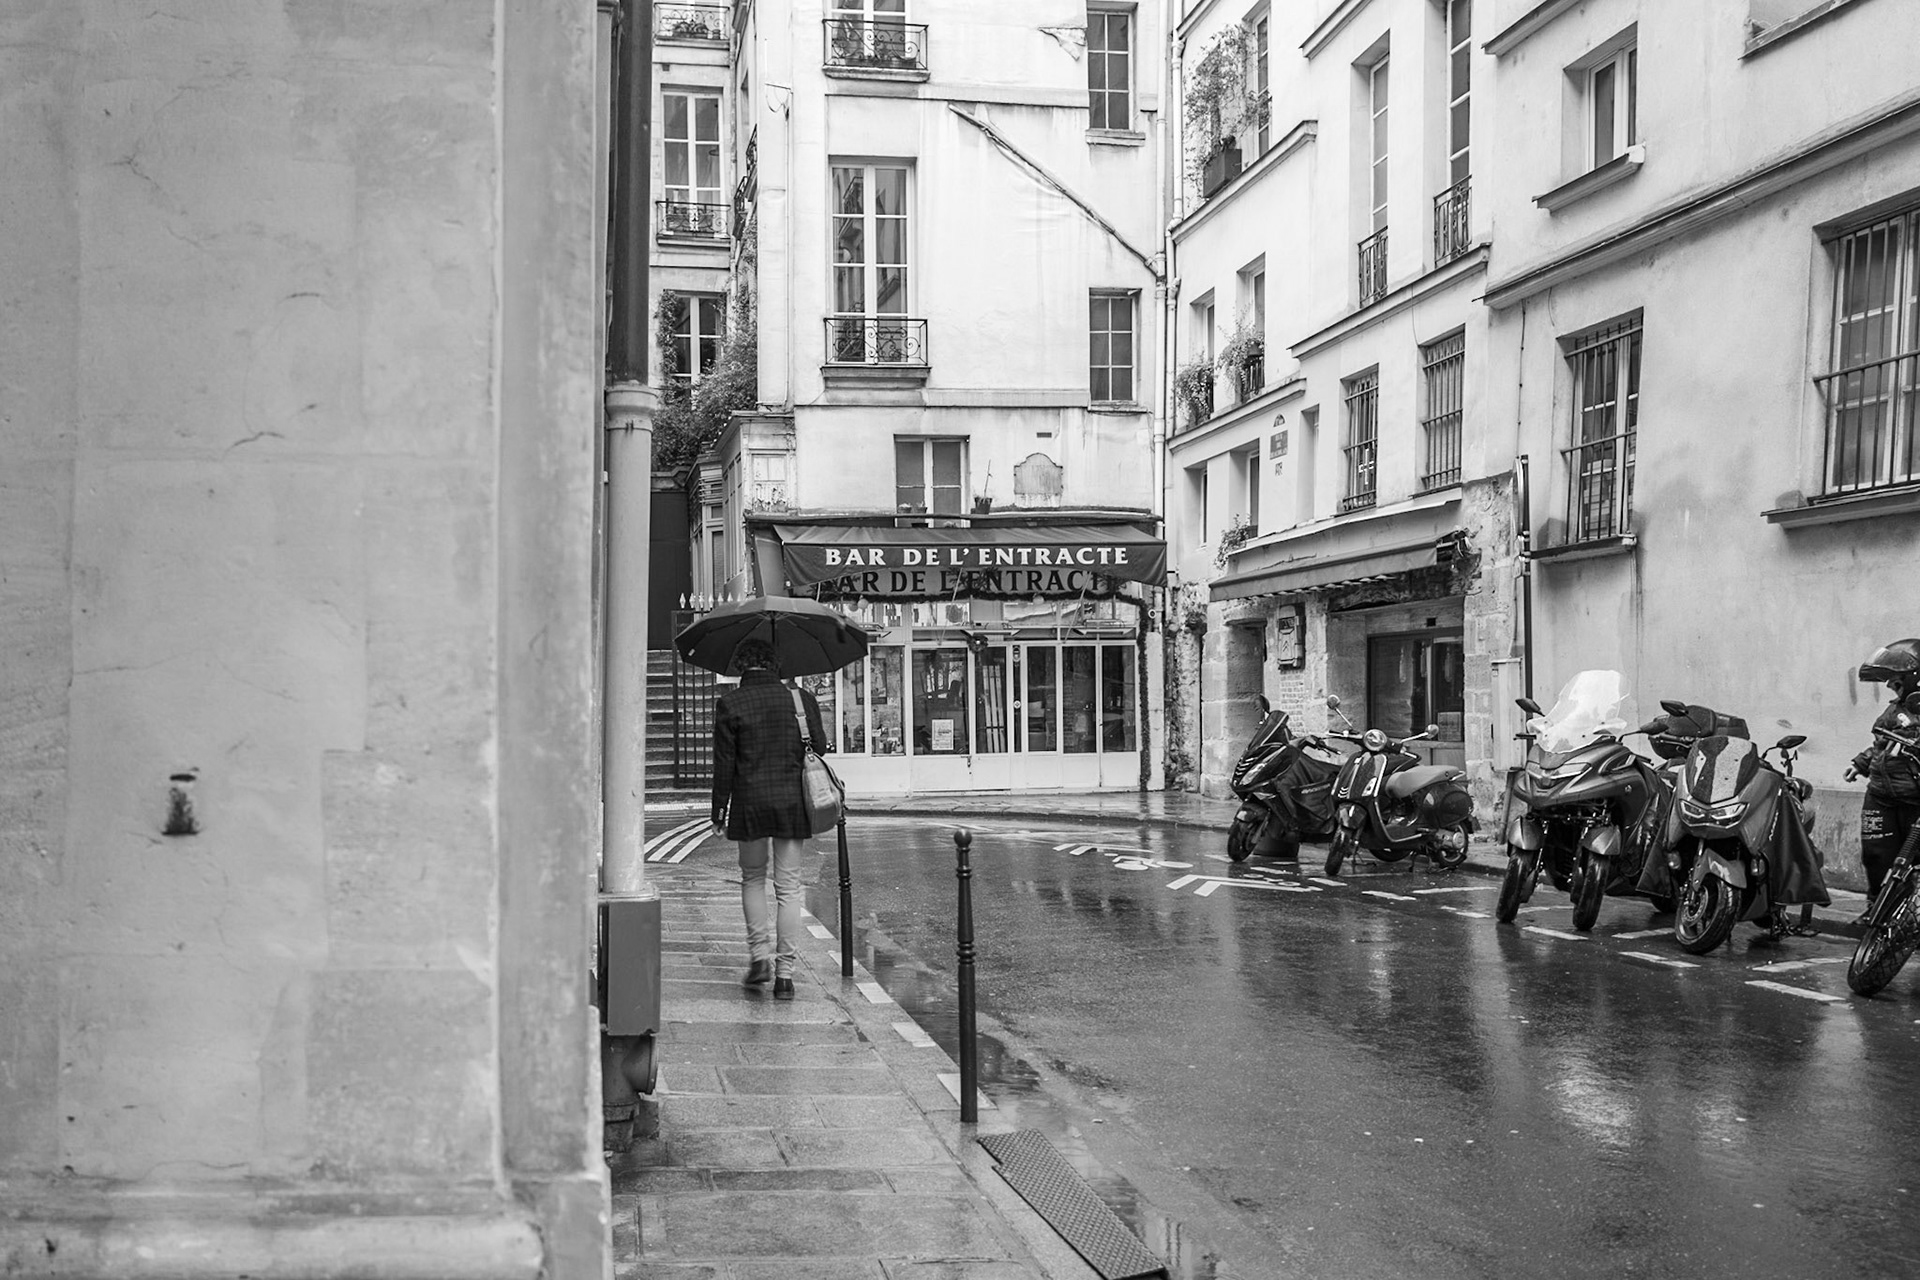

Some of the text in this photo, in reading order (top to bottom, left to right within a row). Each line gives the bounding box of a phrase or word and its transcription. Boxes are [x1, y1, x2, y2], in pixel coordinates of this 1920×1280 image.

[825, 548, 886, 566] BAR
[903, 548, 940, 566] DE
[821, 571, 880, 592] AR
[890, 570, 926, 592] DE
